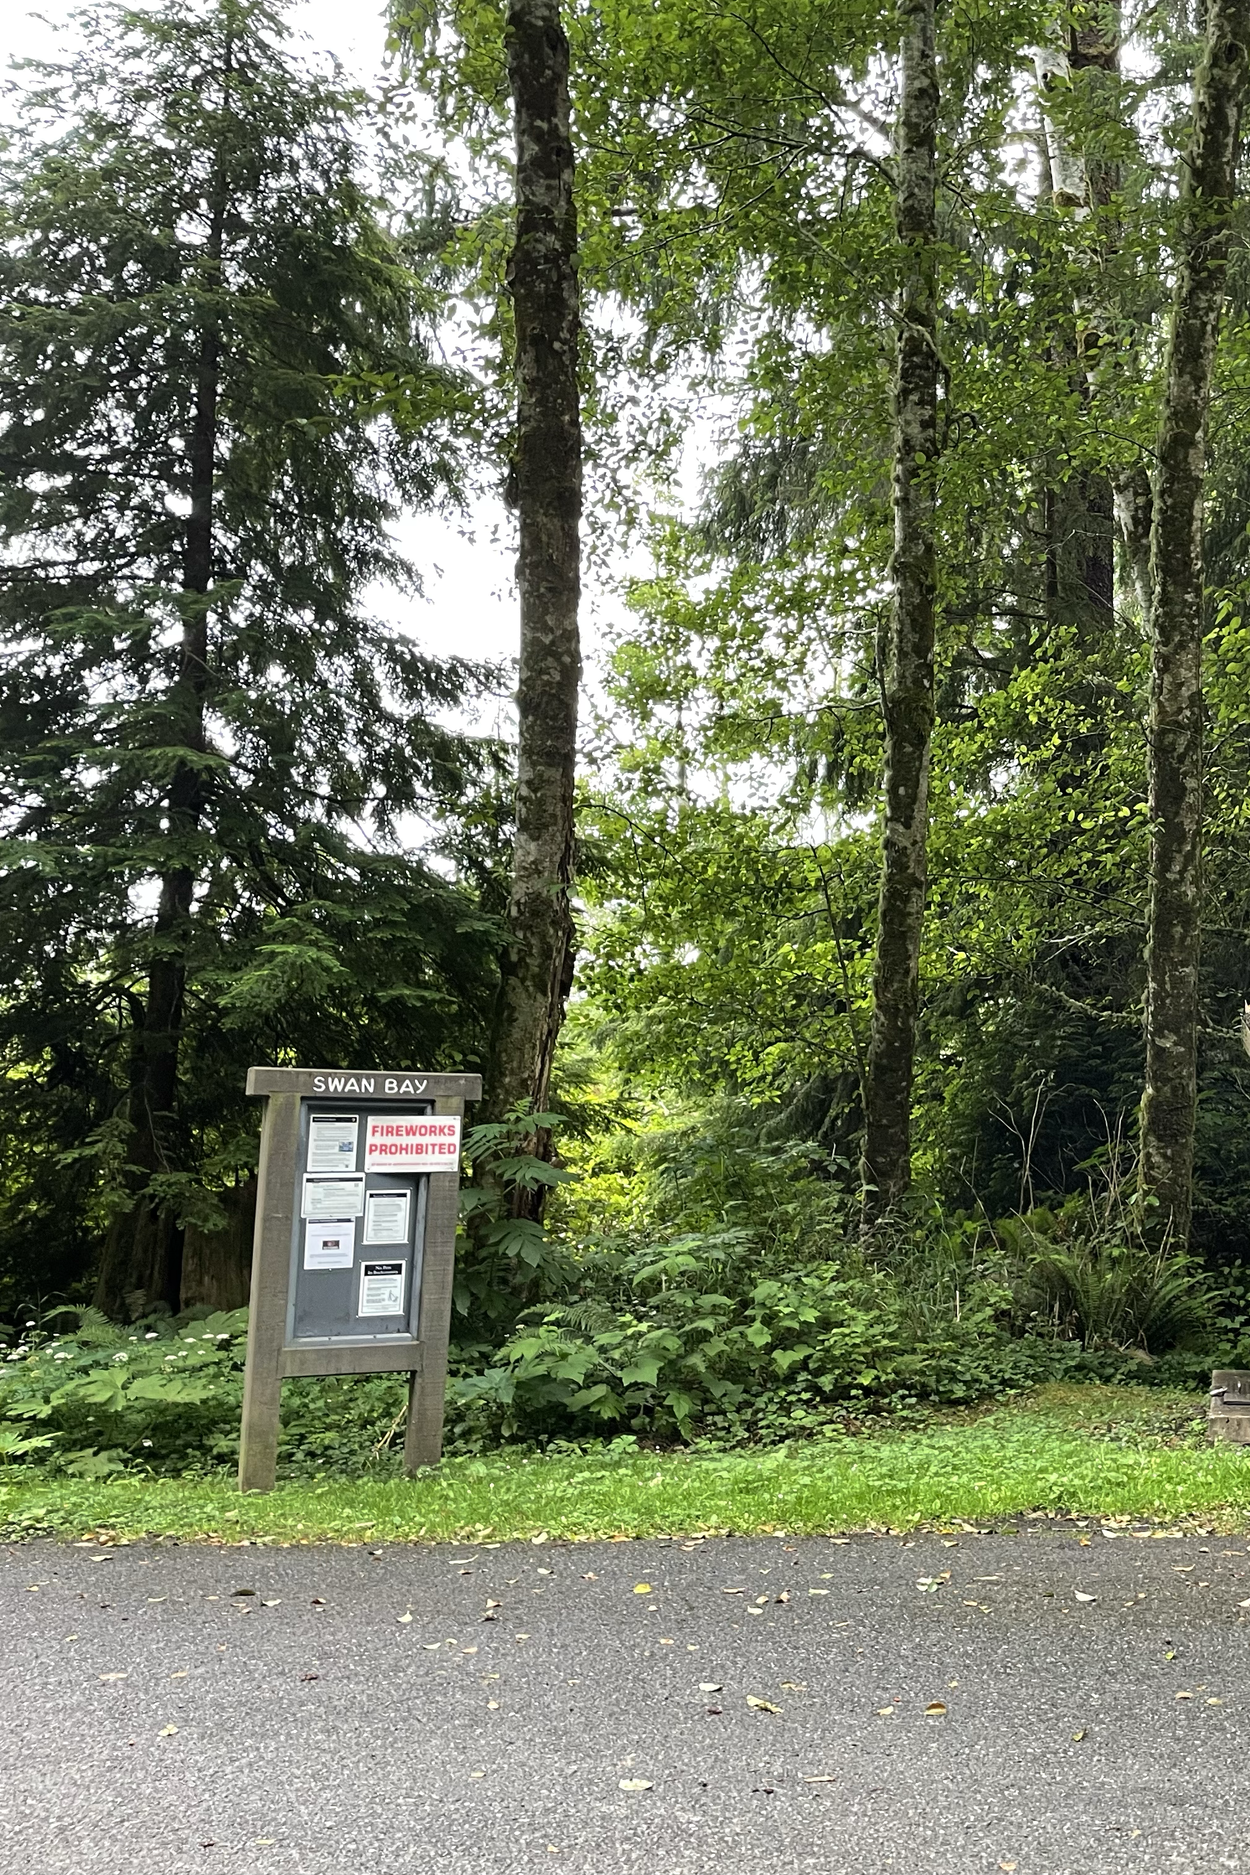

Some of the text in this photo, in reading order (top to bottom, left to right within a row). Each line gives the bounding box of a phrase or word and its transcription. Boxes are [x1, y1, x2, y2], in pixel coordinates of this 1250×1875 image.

[312, 1076, 428, 1094] SWAN BAY
[371, 1124, 456, 1137] FIREWORKS
[369, 1143, 457, 1156] PROHIBITED
